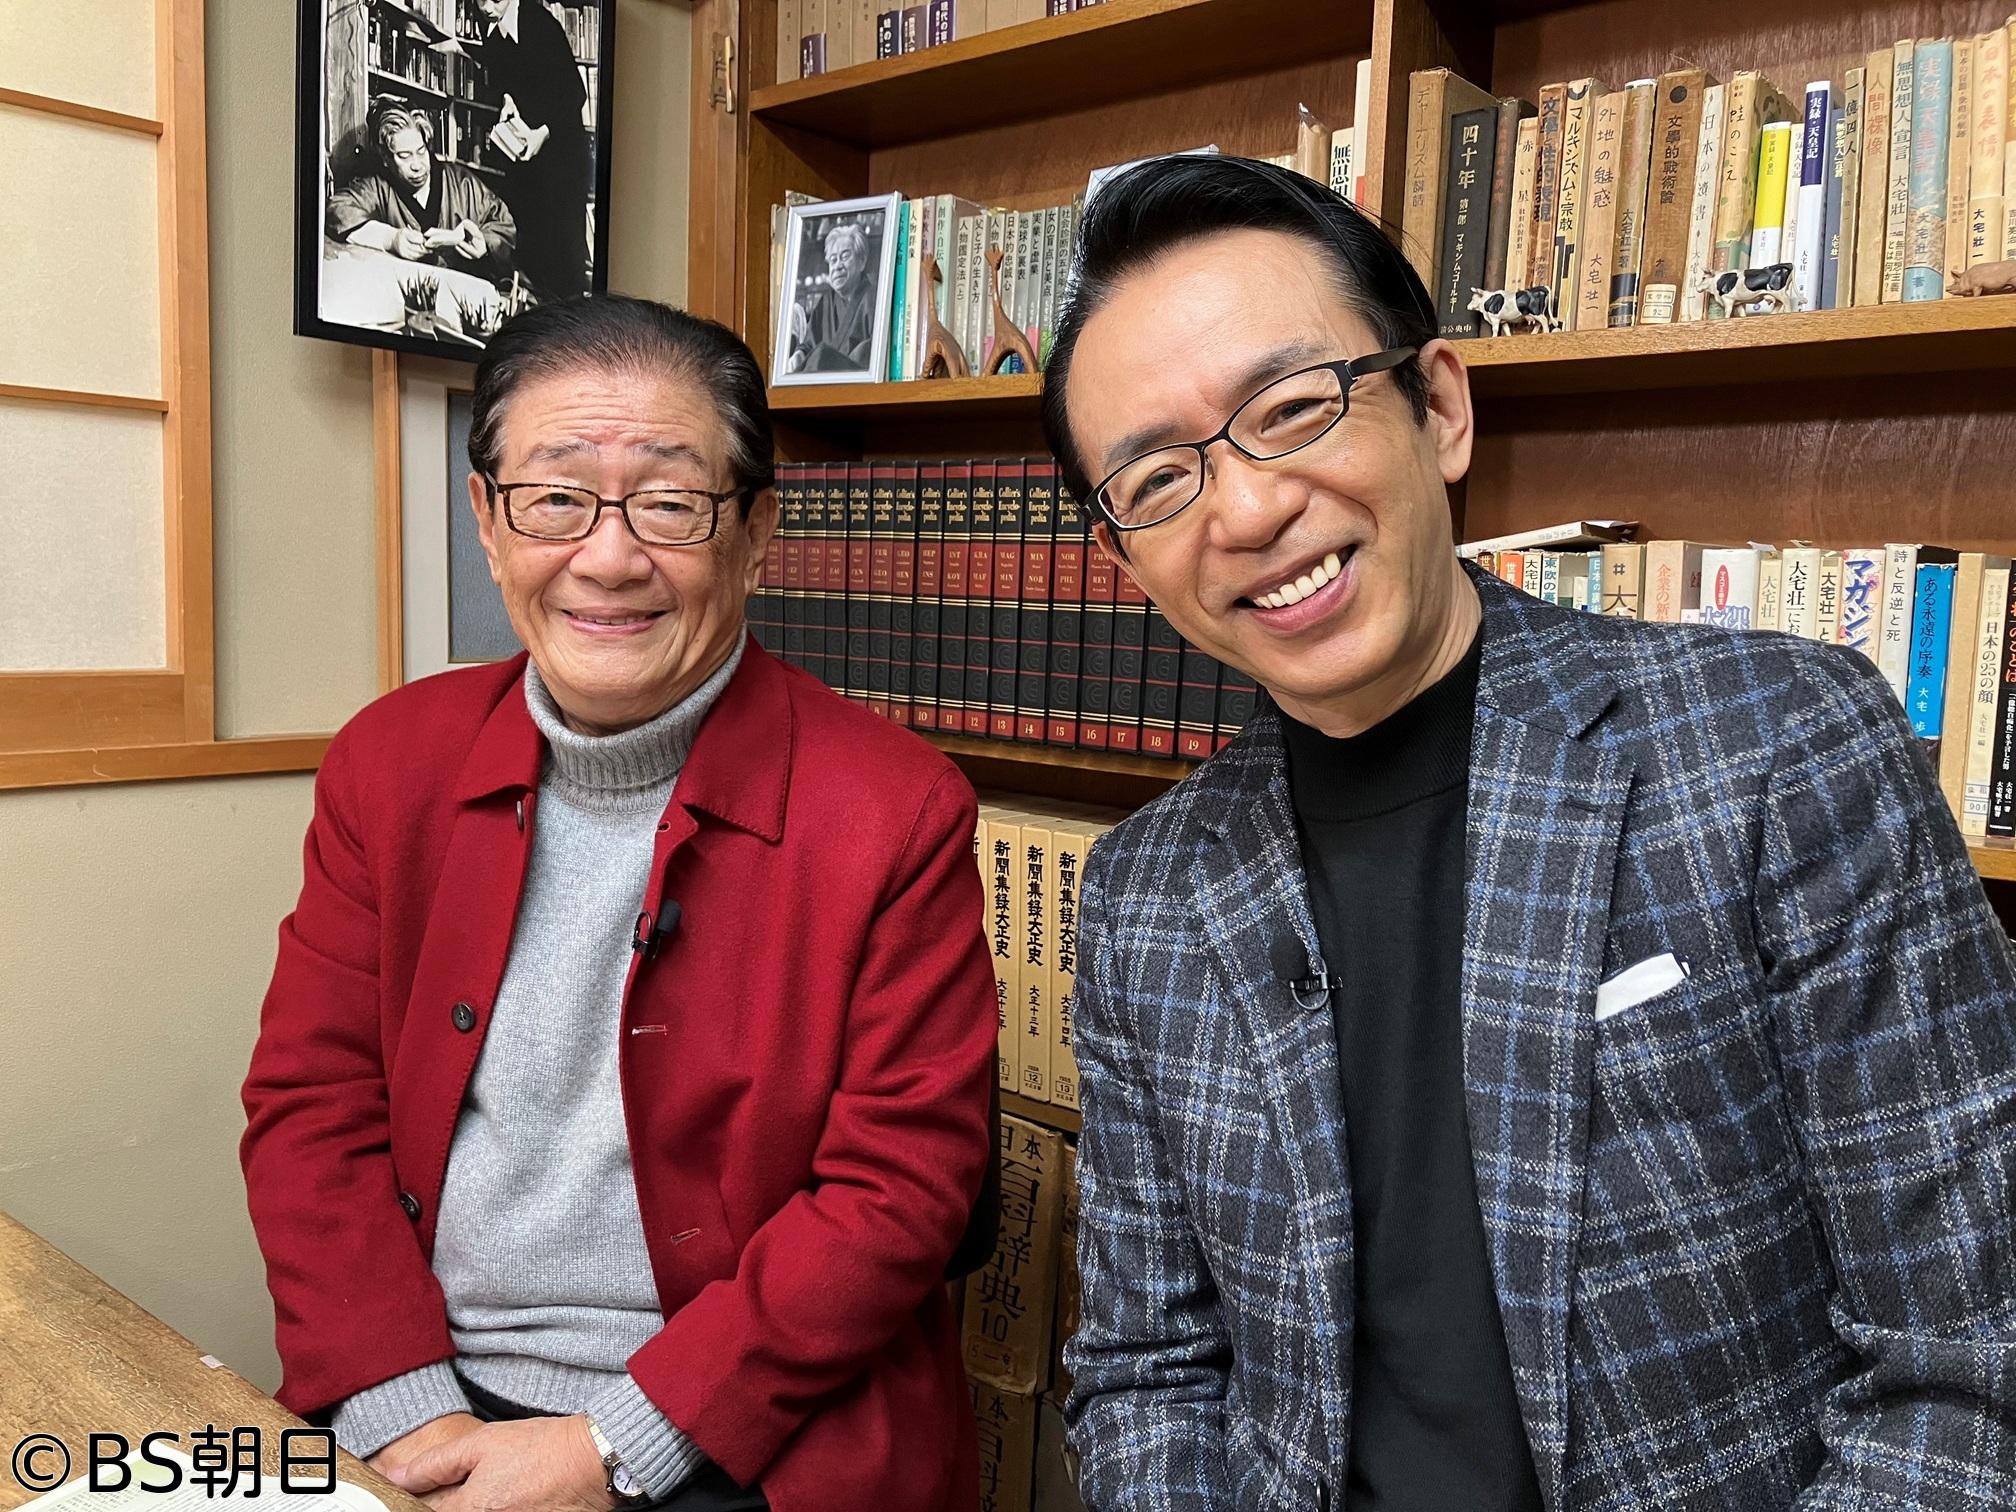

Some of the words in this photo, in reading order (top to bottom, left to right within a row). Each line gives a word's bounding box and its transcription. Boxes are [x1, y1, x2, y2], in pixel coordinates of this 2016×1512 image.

[1894, 61, 1913, 161] 無思想人宣言
[1458, 124, 1480, 190] 四十年
[1592, 107, 1616, 209] 外地の魅惑
[1030, 552, 1044, 560] MIN
[1061, 553, 1076, 561] NOR
[1028, 575, 1044, 584] NOR
[1525, 559, 1539, 597] 大宅壮
[1918, 577, 1938, 679] ある永遠の序奏
[894, 709, 901, 719] 9
[918, 711, 928, 721] 10
[945, 714, 953, 725] 11
[971, 717, 979, 727] 12
[997, 720, 1006, 730] 13
[1024, 723, 1034, 735] 14
[1055, 726, 1065, 737] 15
[1087, 729, 1097, 740] 16
[1117, 732, 1126, 743] 17
[1151, 736, 1162, 747] 18
[1188, 739, 1200, 751] 19
[994, 838, 1012, 960] 新聞集録大正史
[1026, 844, 1045, 968] 新聞集録大正史
[1058, 850, 1077, 977] 新聞集録大正史
[1027, 984, 1041, 1038] 大正十三年
[1059, 993, 1072, 1049] 大正十四年
[1029, 1073, 1039, 1083] 12
[1060, 1083, 1071, 1094] 13
[979, 1307, 1010, 1342] 10
